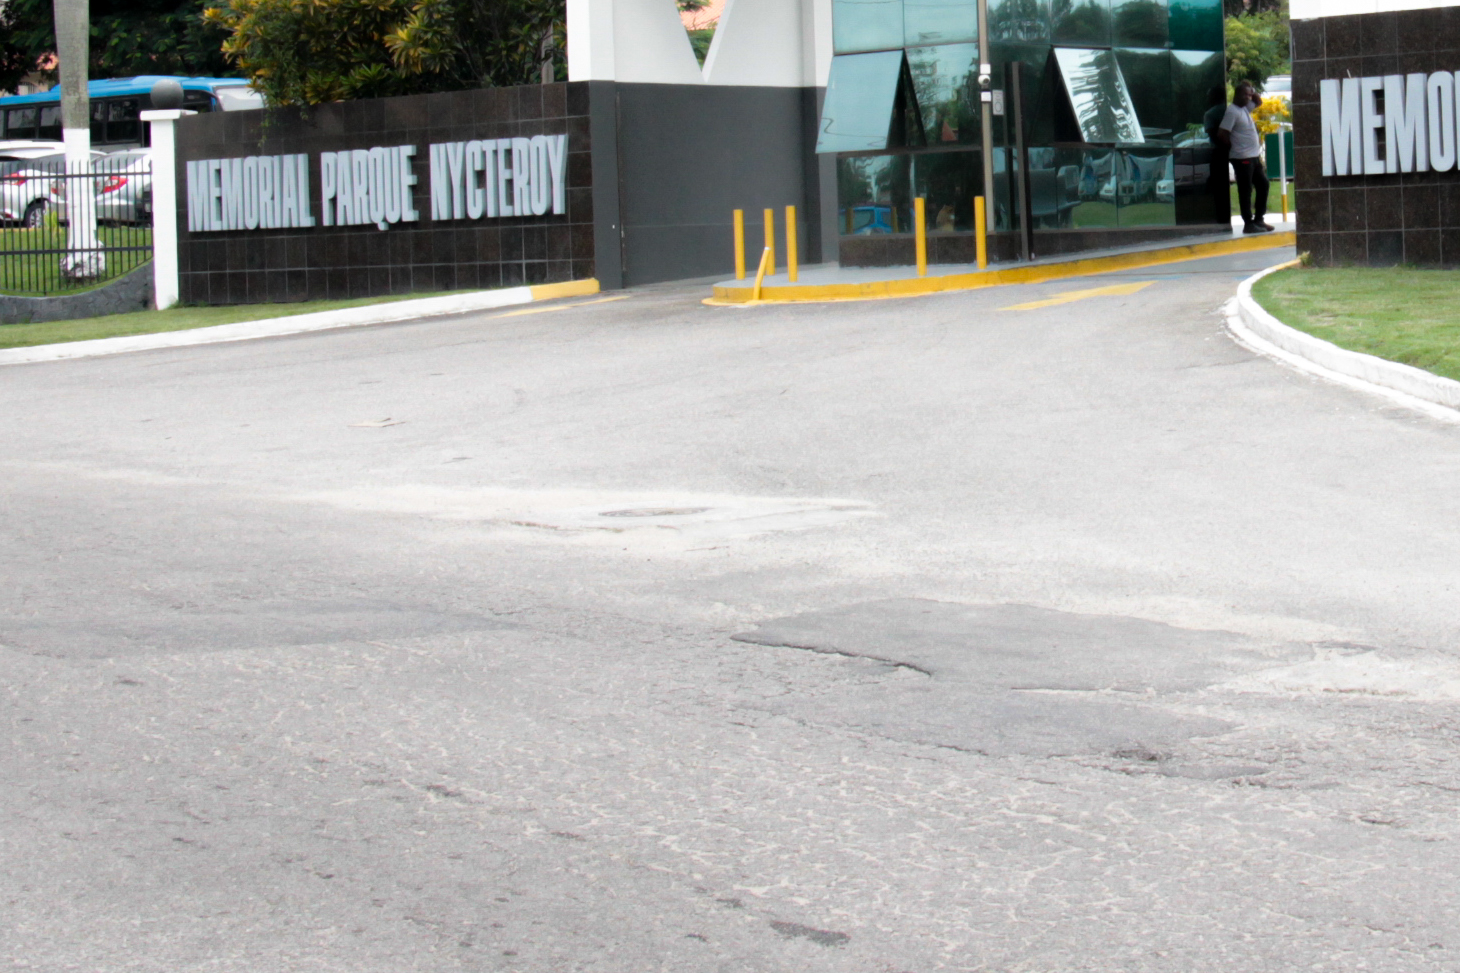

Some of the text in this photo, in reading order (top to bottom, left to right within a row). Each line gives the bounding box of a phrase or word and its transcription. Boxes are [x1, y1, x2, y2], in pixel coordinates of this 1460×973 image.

[186, 134, 569, 232] MEMORIAL PARQUE NYCTEROY
